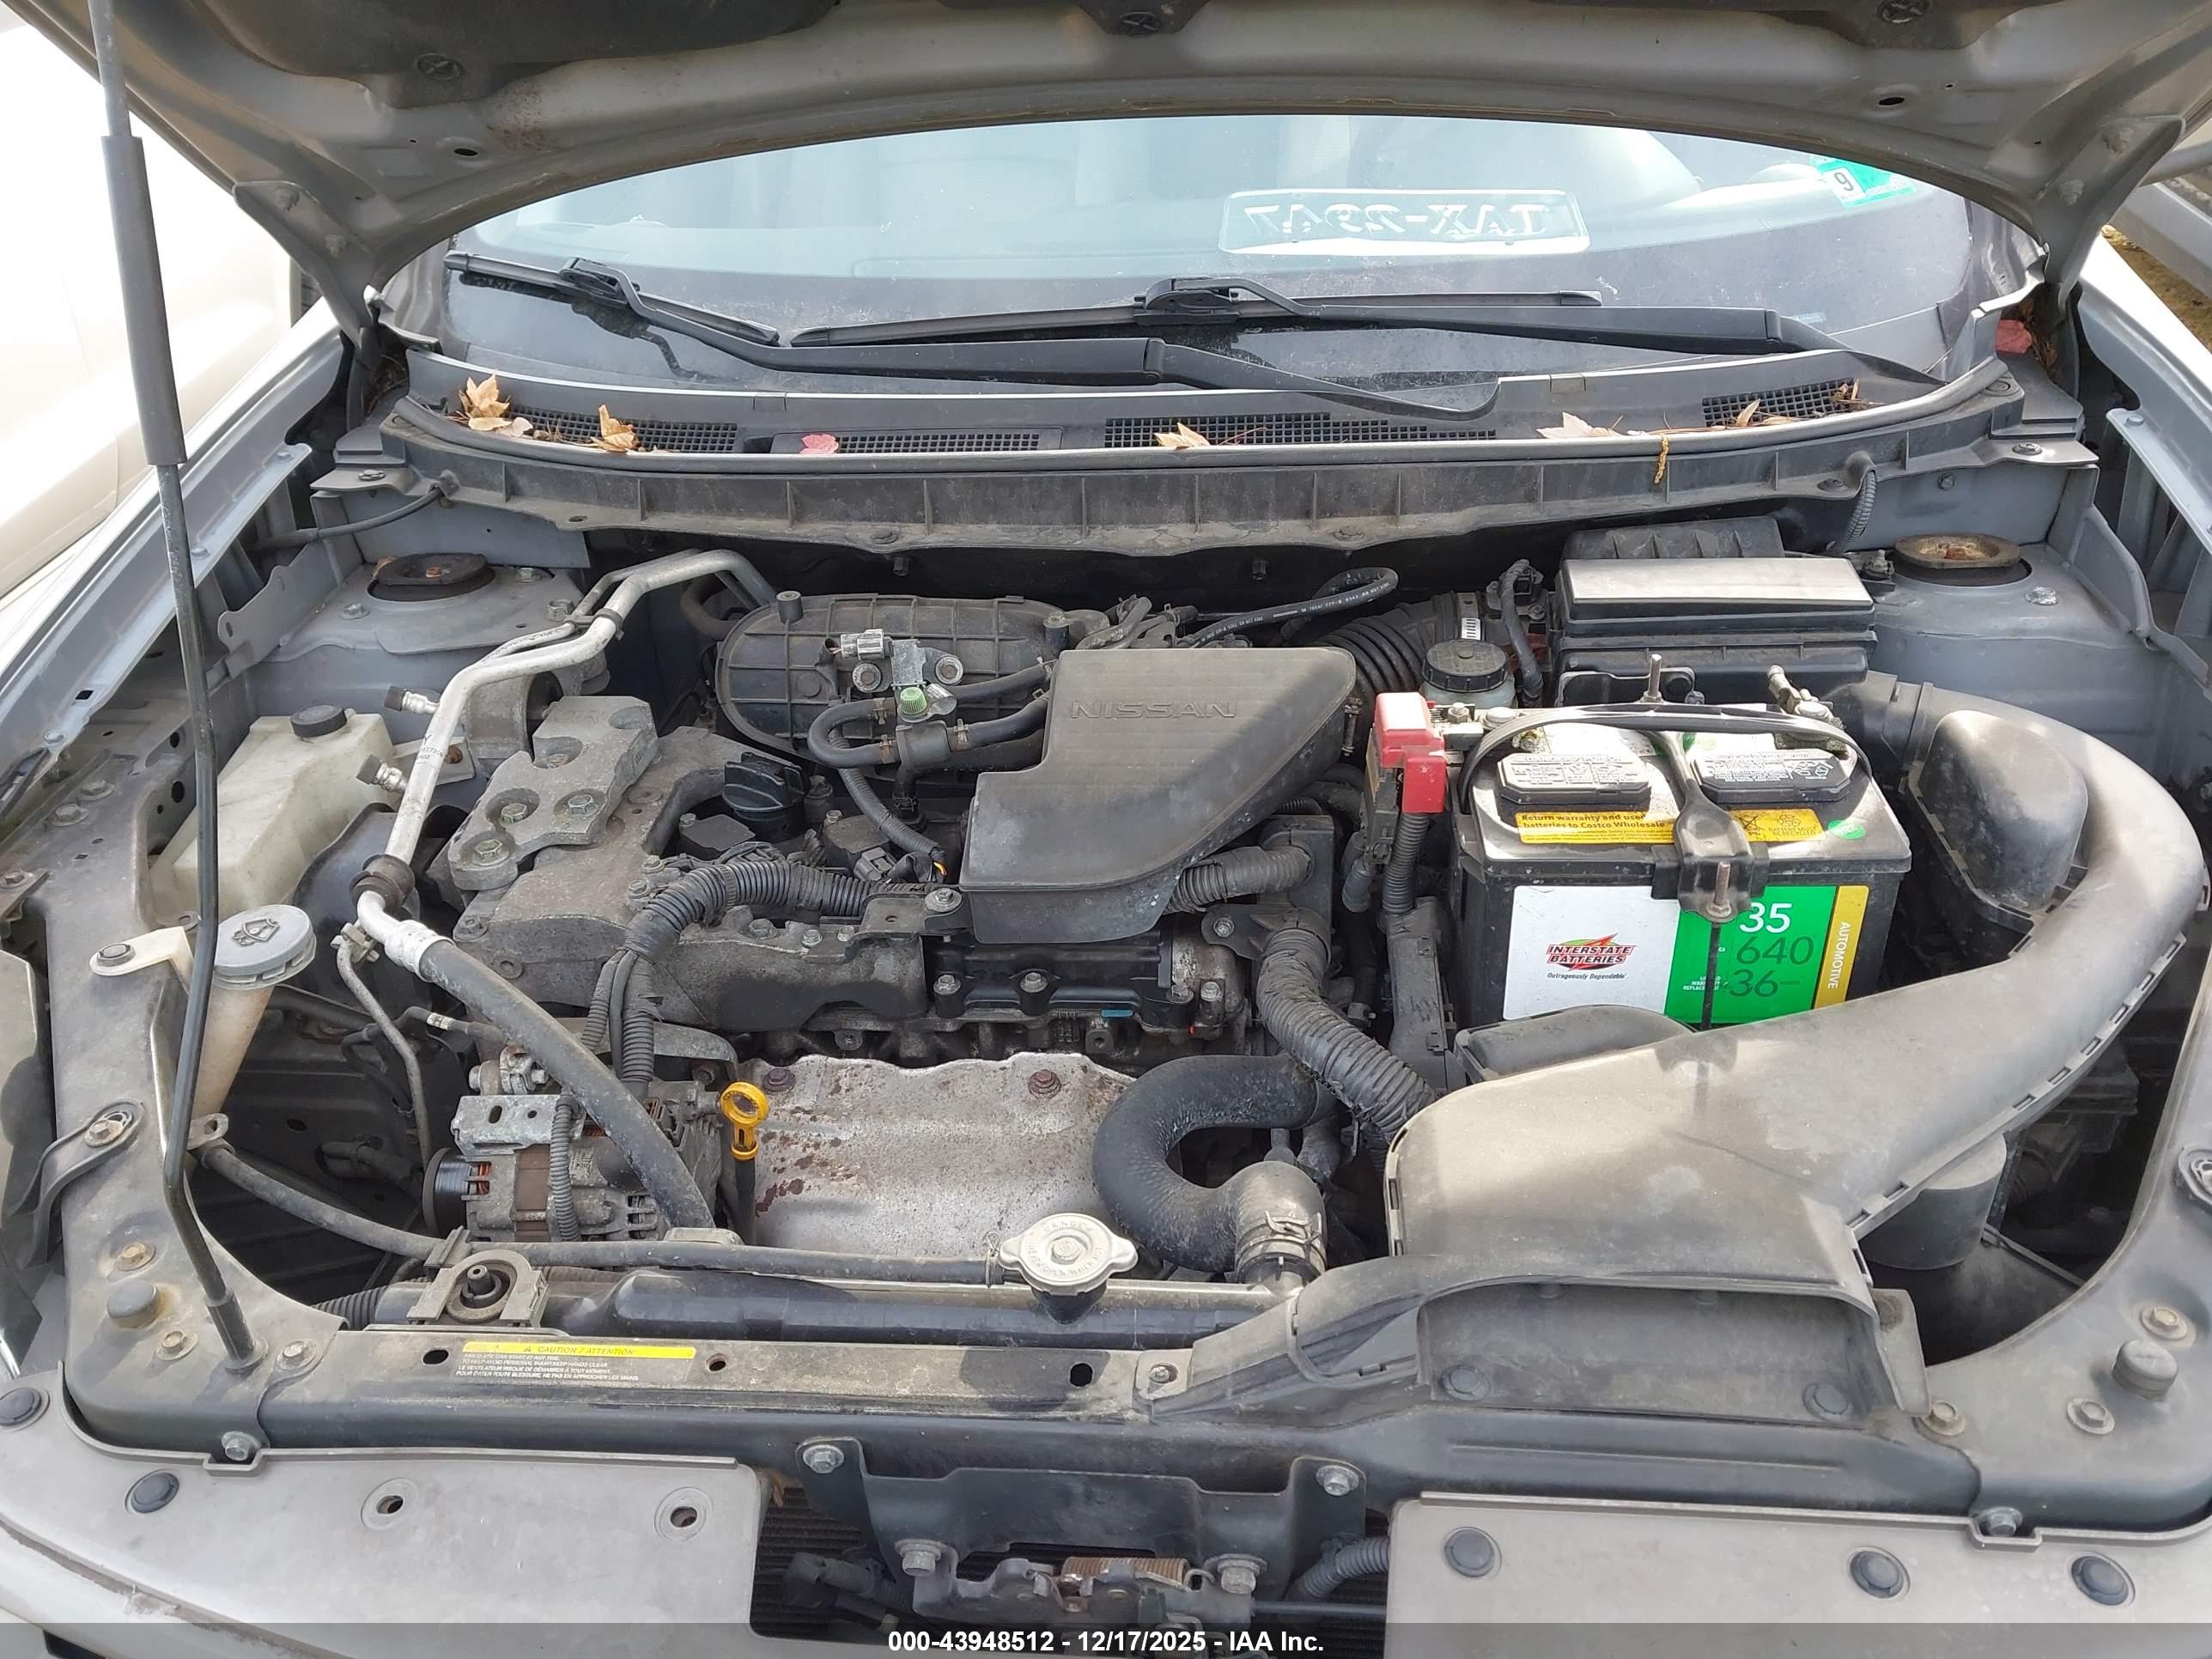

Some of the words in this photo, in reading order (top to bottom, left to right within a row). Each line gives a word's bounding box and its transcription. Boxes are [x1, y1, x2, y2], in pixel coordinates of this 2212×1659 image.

[1071, 700, 1237, 719] NISSAN
[1739, 902, 1793, 933] 35
[1548, 946, 1632, 955] INTERSTATE
[1550, 955, 1625, 963] BATTERIES
[1736, 935, 1814, 966] 640
[1827, 921, 1851, 990] AUTOMOTIVE
[1547, 972, 1589, 981] Outrageously
[1729, 969, 1779, 998] 36
[537, 1346, 577, 1354] CAUTION
[586, 1346, 635, 1356] ATTENTION
